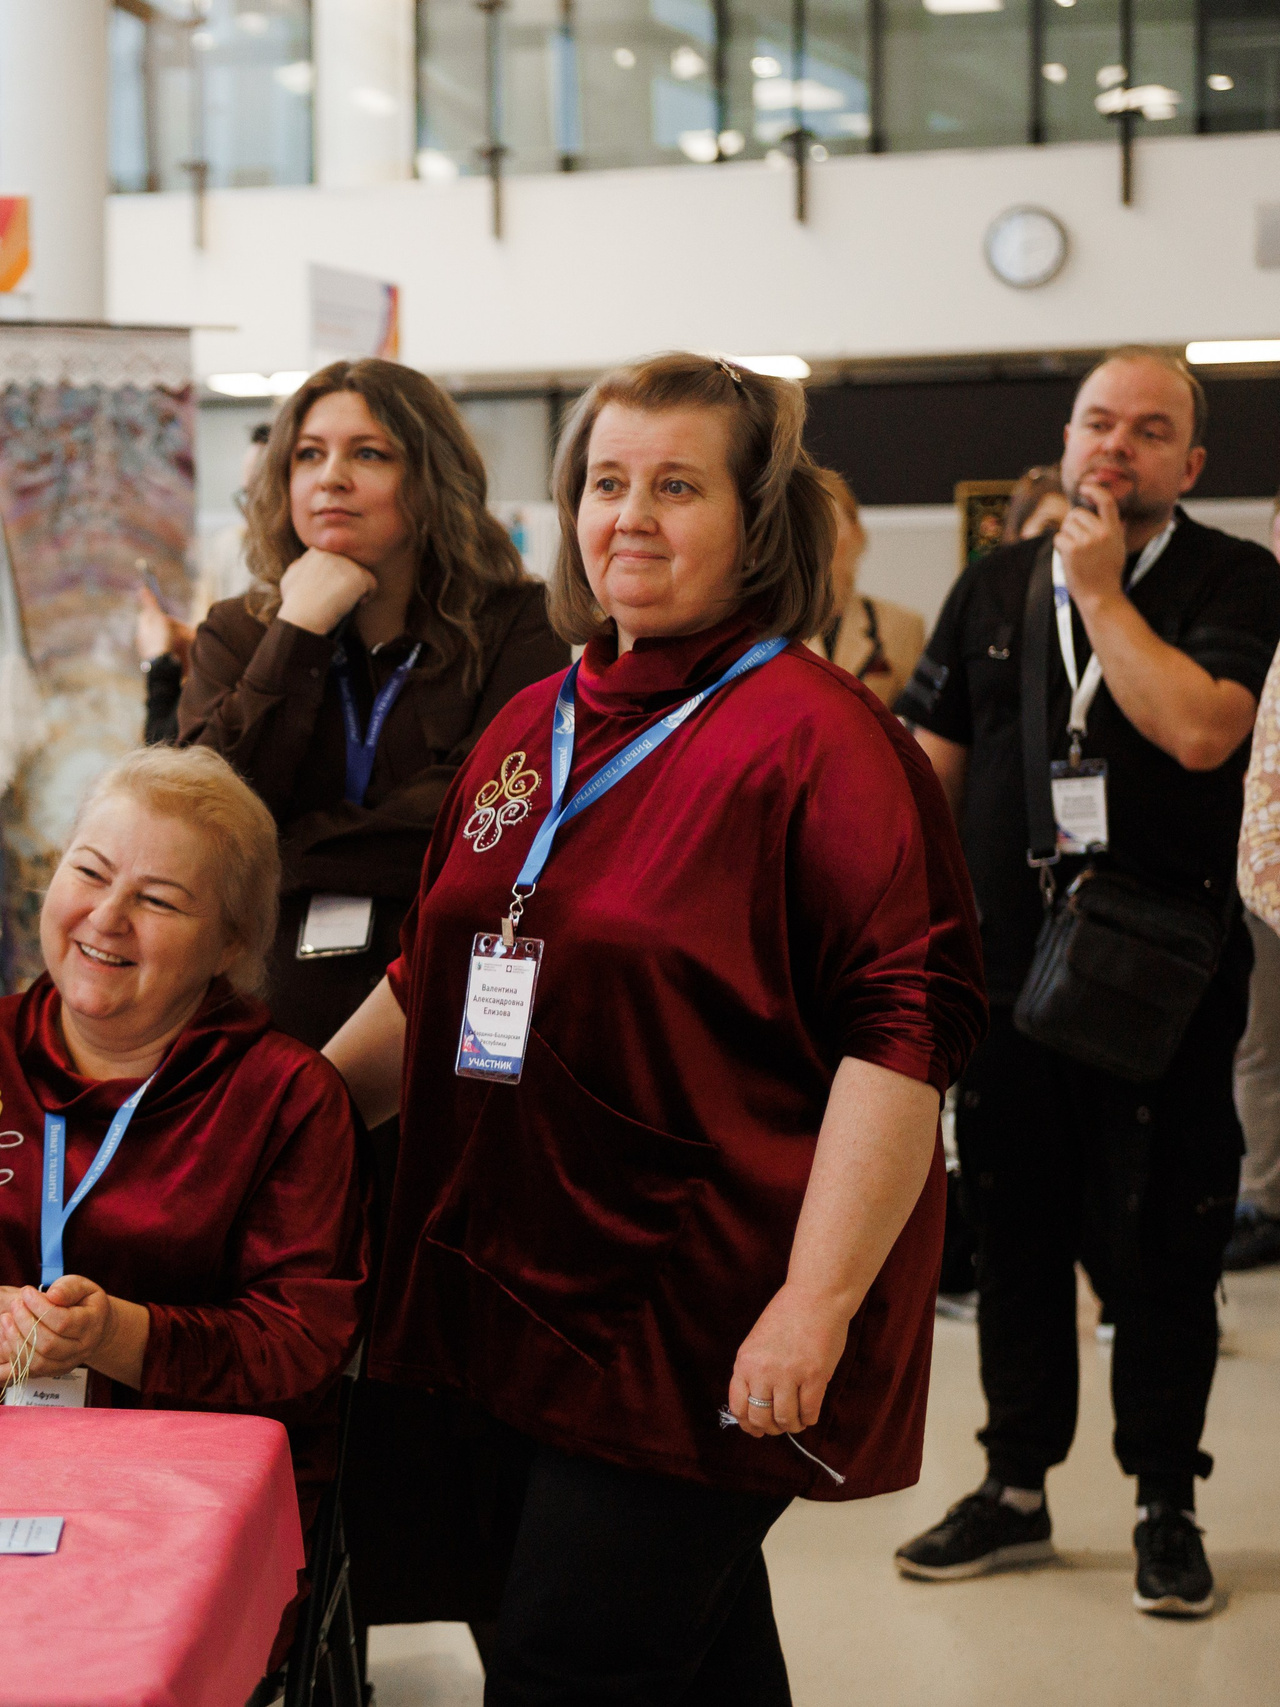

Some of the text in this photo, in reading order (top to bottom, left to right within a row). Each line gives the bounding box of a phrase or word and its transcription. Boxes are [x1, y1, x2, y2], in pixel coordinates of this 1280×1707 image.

[573, 738, 653, 810] Виват, таланты!
[481, 983, 518, 995] Валентина
[472, 994, 525, 1007] Александровна
[483, 1006, 511, 1018] Елизова
[468, 1057, 513, 1071] УЧАСТНИК
[95, 1123, 123, 1172] таланты!
[48, 1124, 61, 1203] Виват, таланты!
